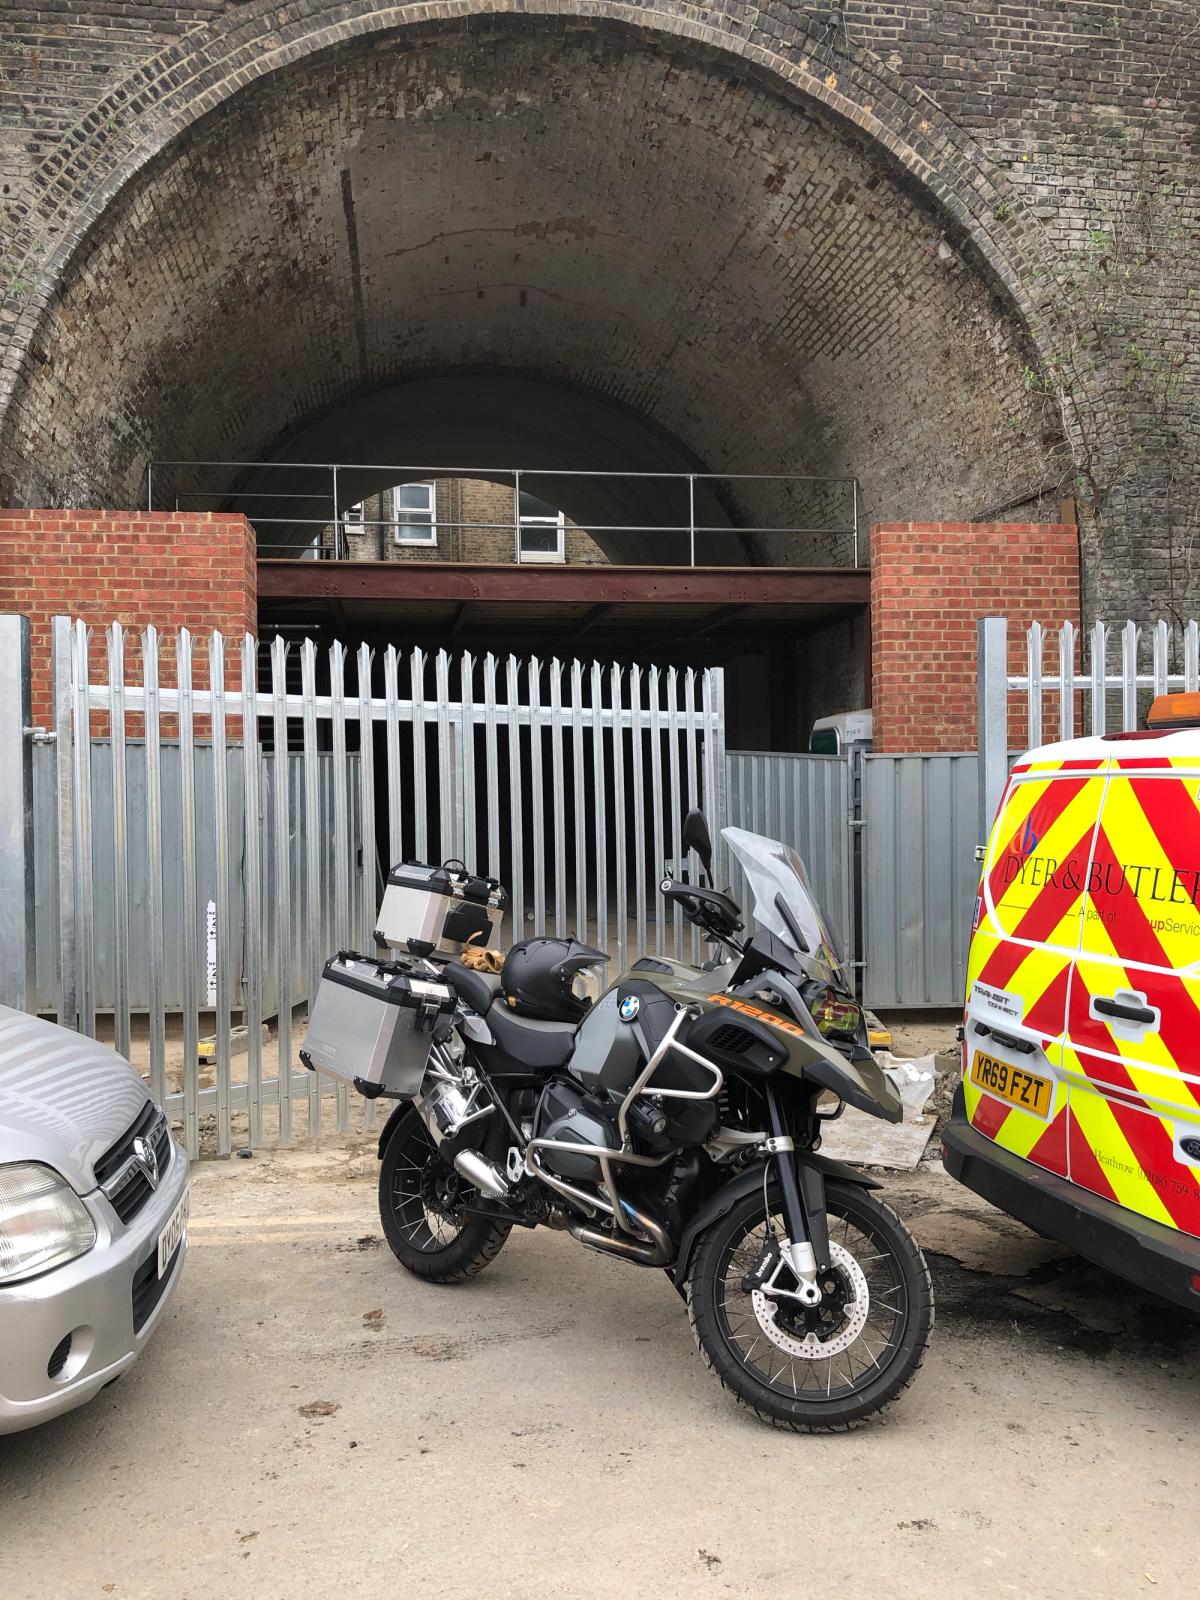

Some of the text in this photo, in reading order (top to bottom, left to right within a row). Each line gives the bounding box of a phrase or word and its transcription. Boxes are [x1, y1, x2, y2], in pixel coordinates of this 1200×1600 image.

[1004, 855, 1060, 888] DYER
[1062, 860, 1084, 891] &
[1077, 906, 1086, 918] A
[1086, 909, 1105, 921] part
[1107, 911, 1117, 923] of
[707, 994, 805, 1036] R1200
[976, 1054, 1044, 1107] YR69 FZT
[1094, 1149, 1135, 1175] Heathrow
[1171, 1179, 1189, 1196] 759
[755, 1252, 773, 1277] brembo
